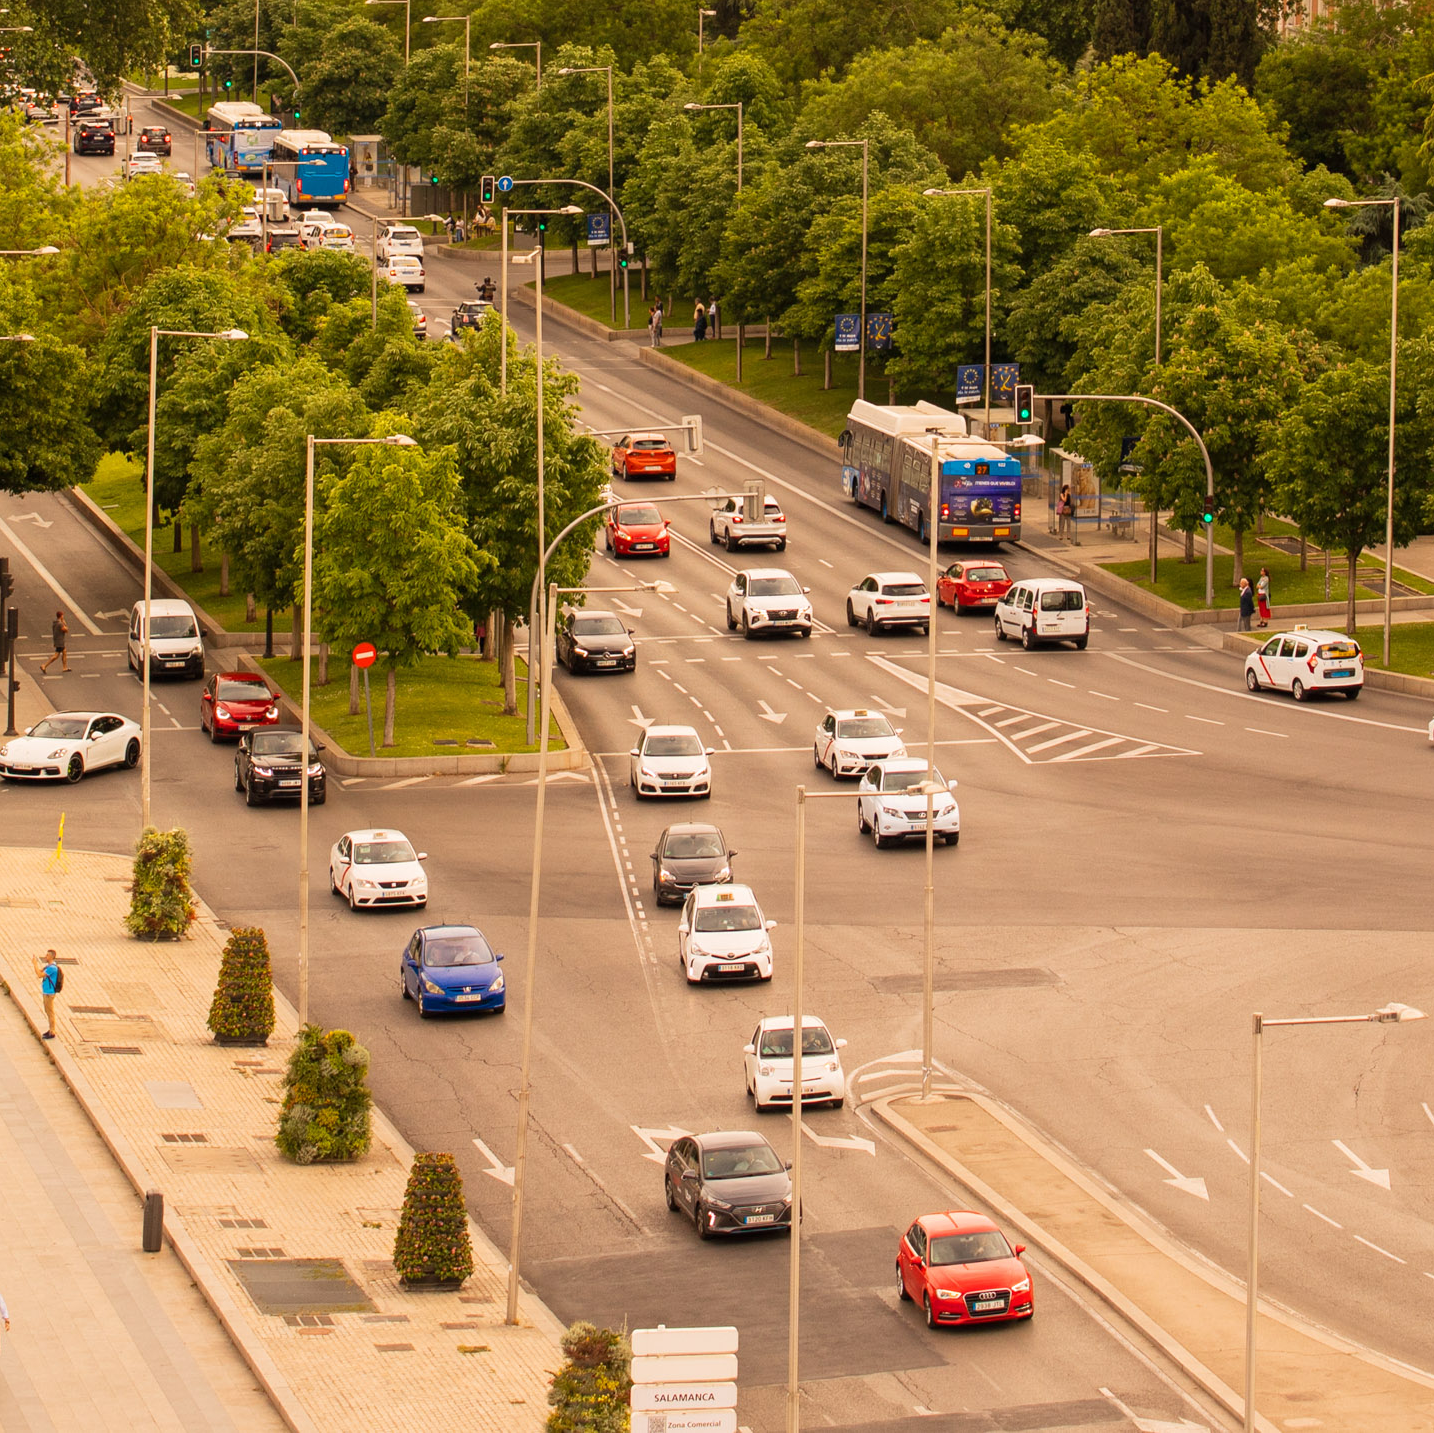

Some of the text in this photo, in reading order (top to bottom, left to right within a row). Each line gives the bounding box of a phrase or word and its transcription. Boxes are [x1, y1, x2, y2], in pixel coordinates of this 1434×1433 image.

[976, 465, 988, 475] 27
[654, 1393, 715, 1403] SALAMANCA
[668, 1420, 721, 1429] Zona Comercial
